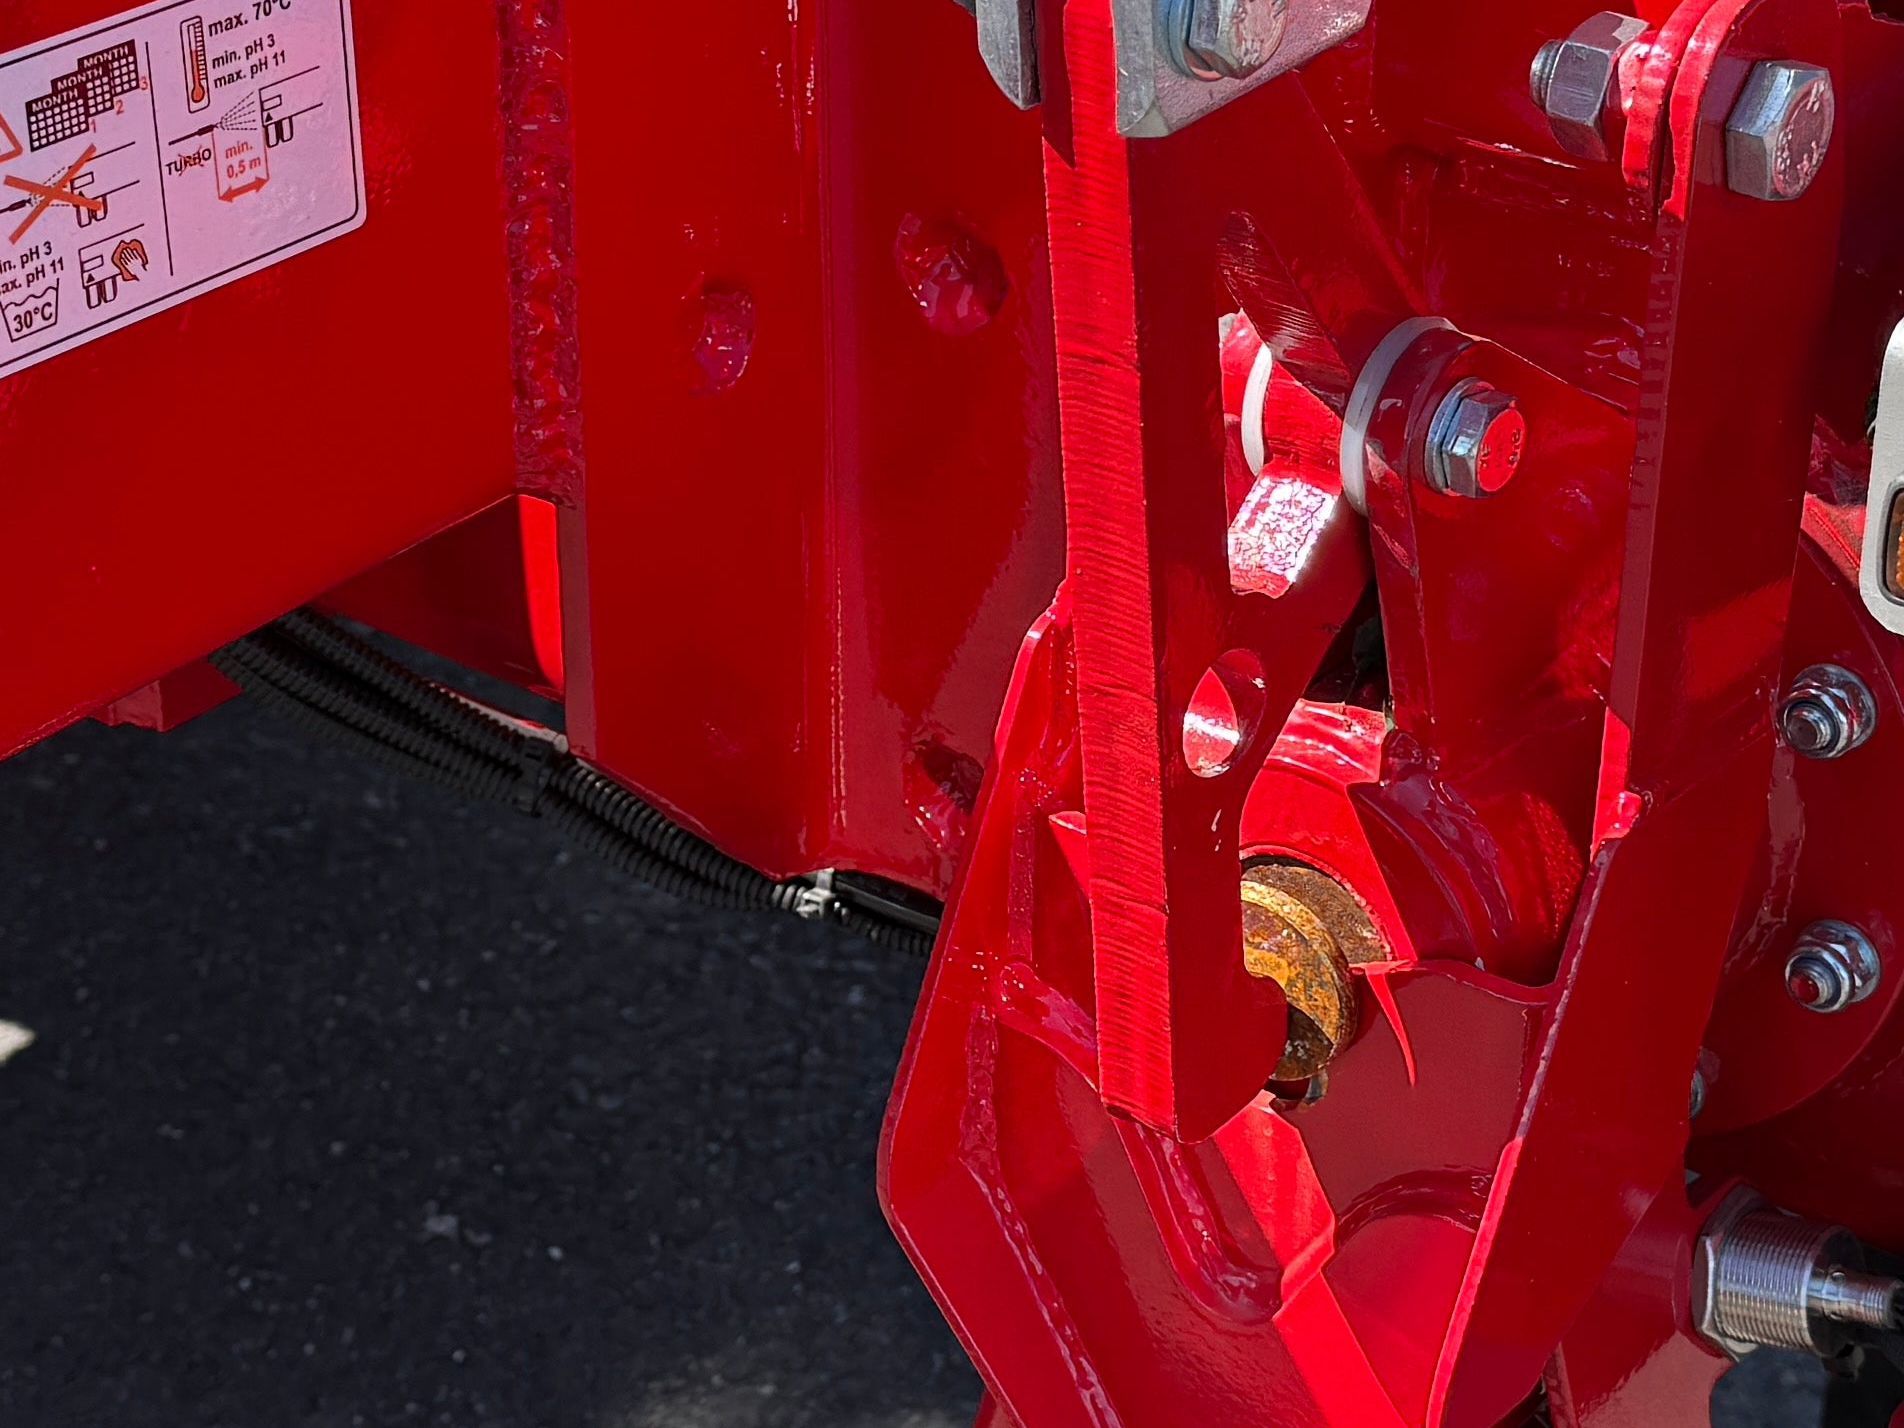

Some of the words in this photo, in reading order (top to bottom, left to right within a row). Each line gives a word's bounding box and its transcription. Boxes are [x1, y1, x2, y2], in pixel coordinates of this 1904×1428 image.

[208, 13, 248, 37] max.
[83, 45, 129, 68] MONTH
[212, 50, 241, 69] min.
[245, 37, 264, 60] pH
[267, 33, 275, 48] 3
[57, 67, 103, 90] MONTH
[213, 69, 246, 88] max.
[250, 56, 268, 79] pH
[273, 49, 285, 66] 11
[139, 76, 149, 91] 3
[31, 88, 78, 112] MONTH
[115, 99, 124, 115] 2
[90, 118, 96, 133] 1
[225, 140, 253, 159] min.
[165, 148, 212, 176] TURBO
[227, 159, 246, 179] 0,5
[249, 157, 261, 170] m
[20, 245, 40, 269] pH
[43, 240, 52, 256] 3
[26, 263, 46, 288] pH
[50, 256, 64, 274] 11
[13, 302, 53, 333] 30°C
